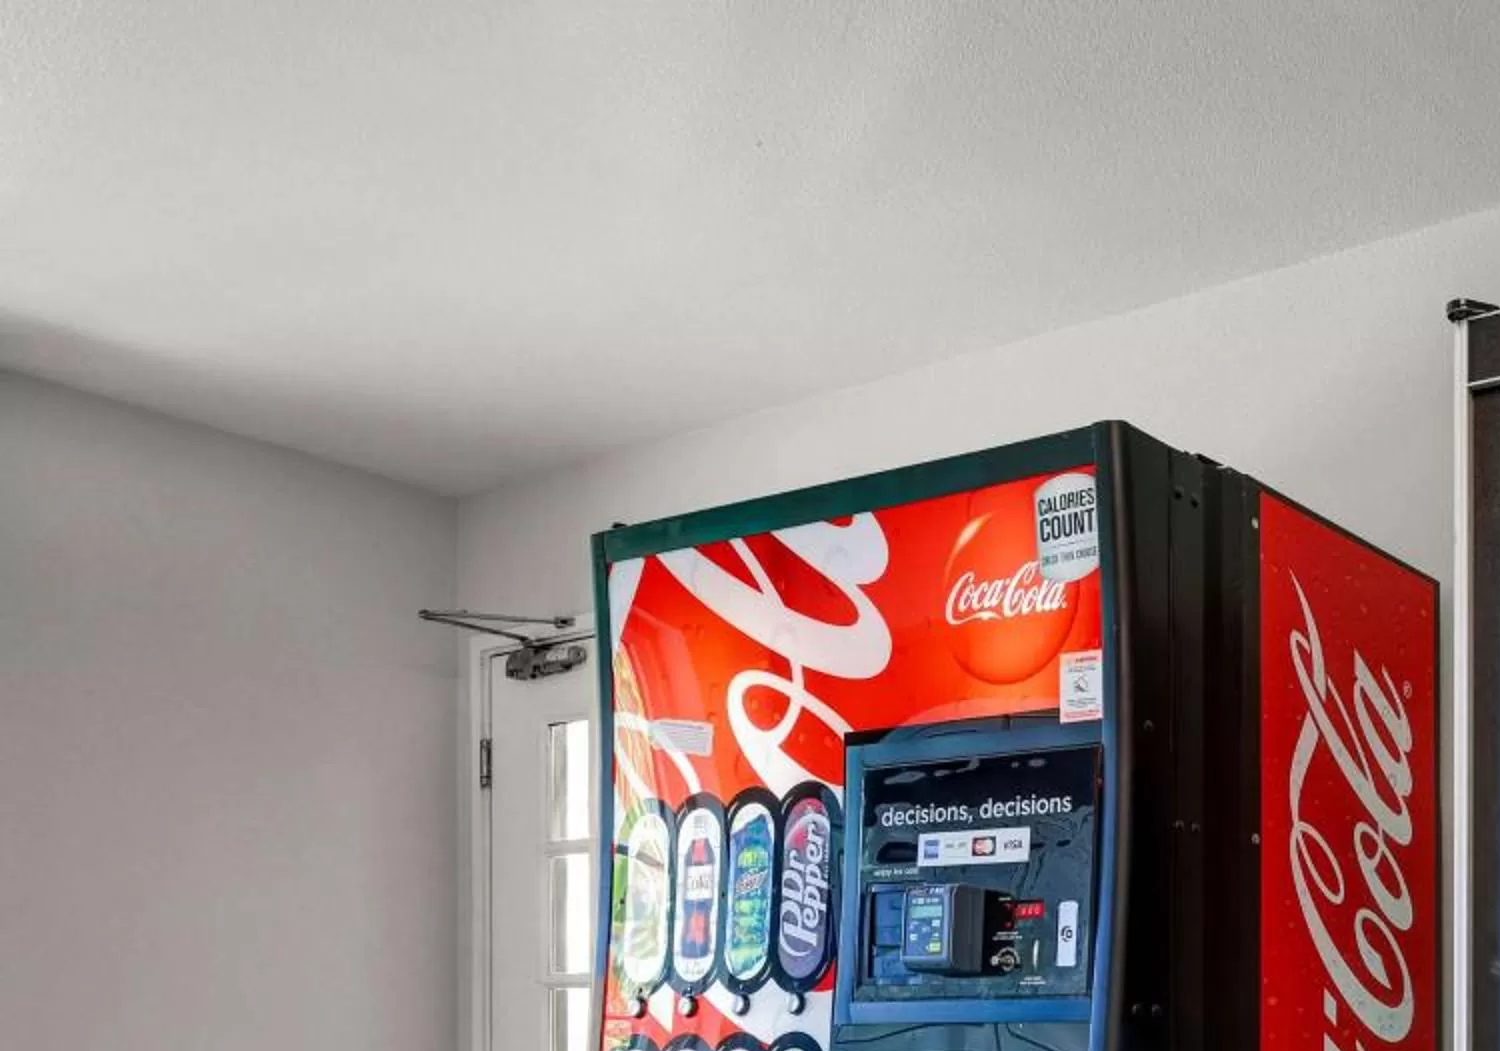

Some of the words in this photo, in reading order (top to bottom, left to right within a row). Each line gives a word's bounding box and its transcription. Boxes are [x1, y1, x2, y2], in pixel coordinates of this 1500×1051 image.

[1037, 487, 1096, 517] CALORIES
[1039, 507, 1096, 543] COUNT
[945, 560, 1067, 625] Coca-Cola
[881, 803, 974, 827] decisions,
[979, 794, 1073, 819] decisions
[781, 850, 805, 902] Dr
[782, 822, 829, 946] Pepper
